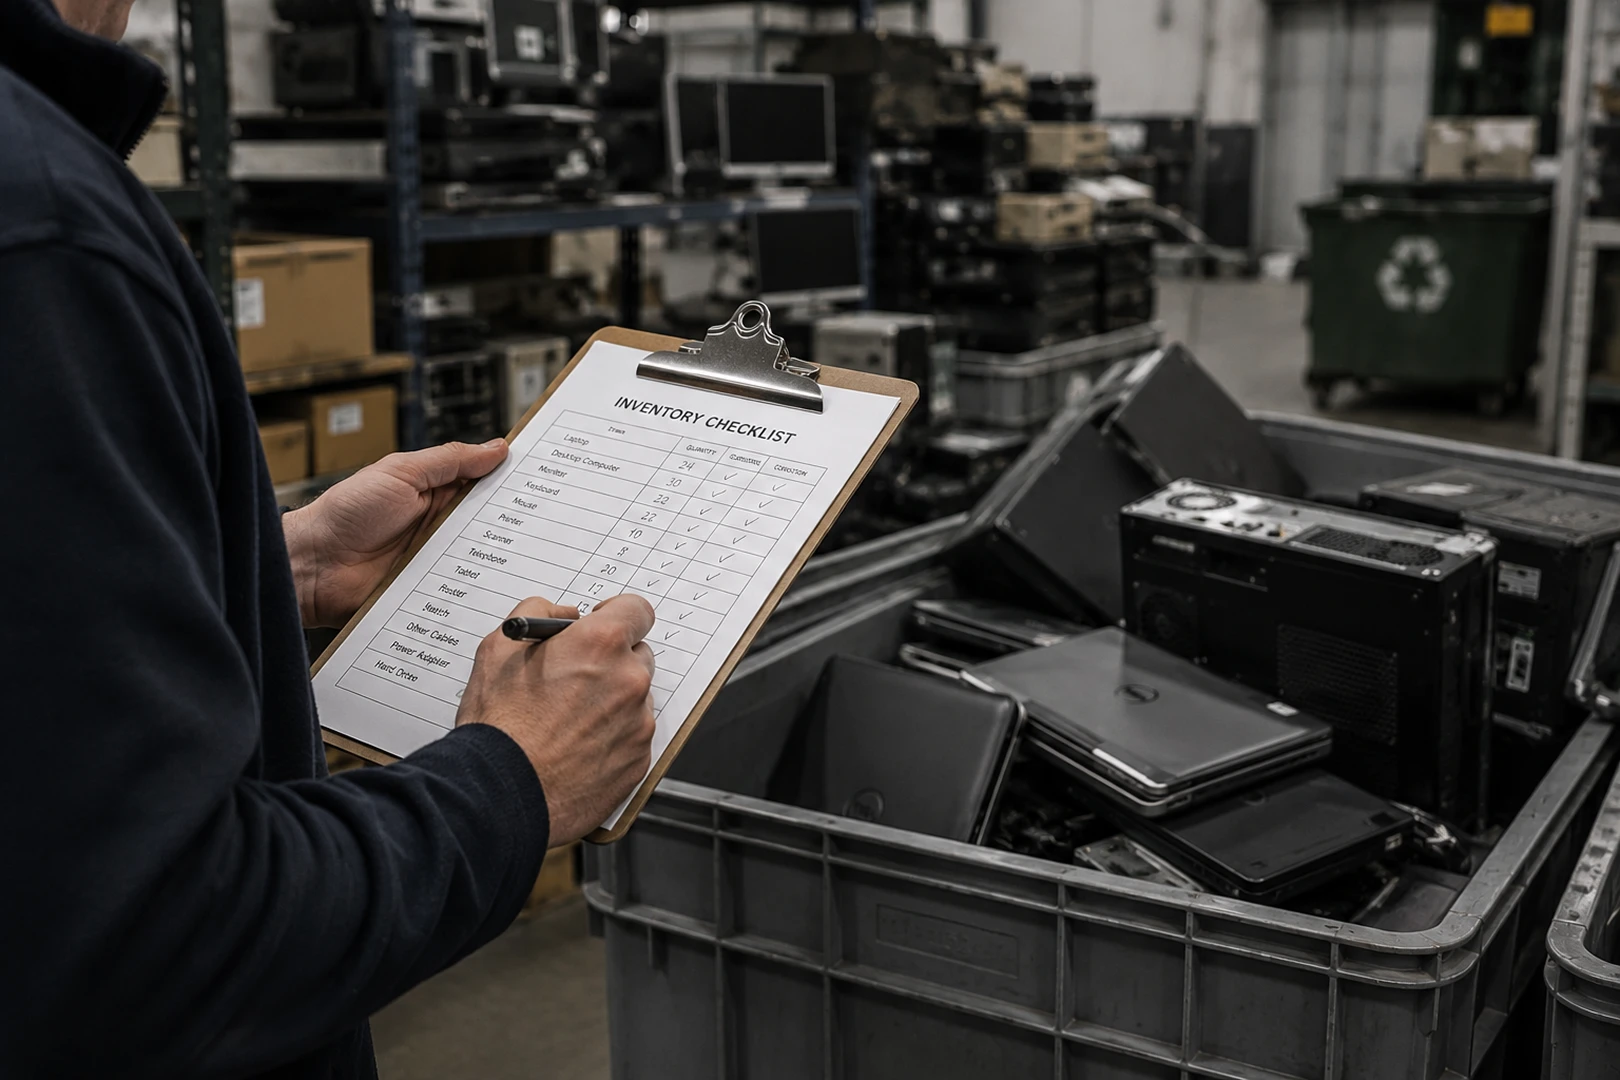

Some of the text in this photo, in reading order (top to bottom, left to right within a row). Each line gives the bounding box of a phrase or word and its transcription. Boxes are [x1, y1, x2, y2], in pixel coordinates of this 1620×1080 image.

[614, 396, 796, 444] INVENTORY CHECKLIST
[678, 461, 695, 471] 24
[666, 477, 682, 487] 30
[628, 528, 643, 539] 10
[600, 563, 617, 576] 20
[389, 641, 417, 655] Power
